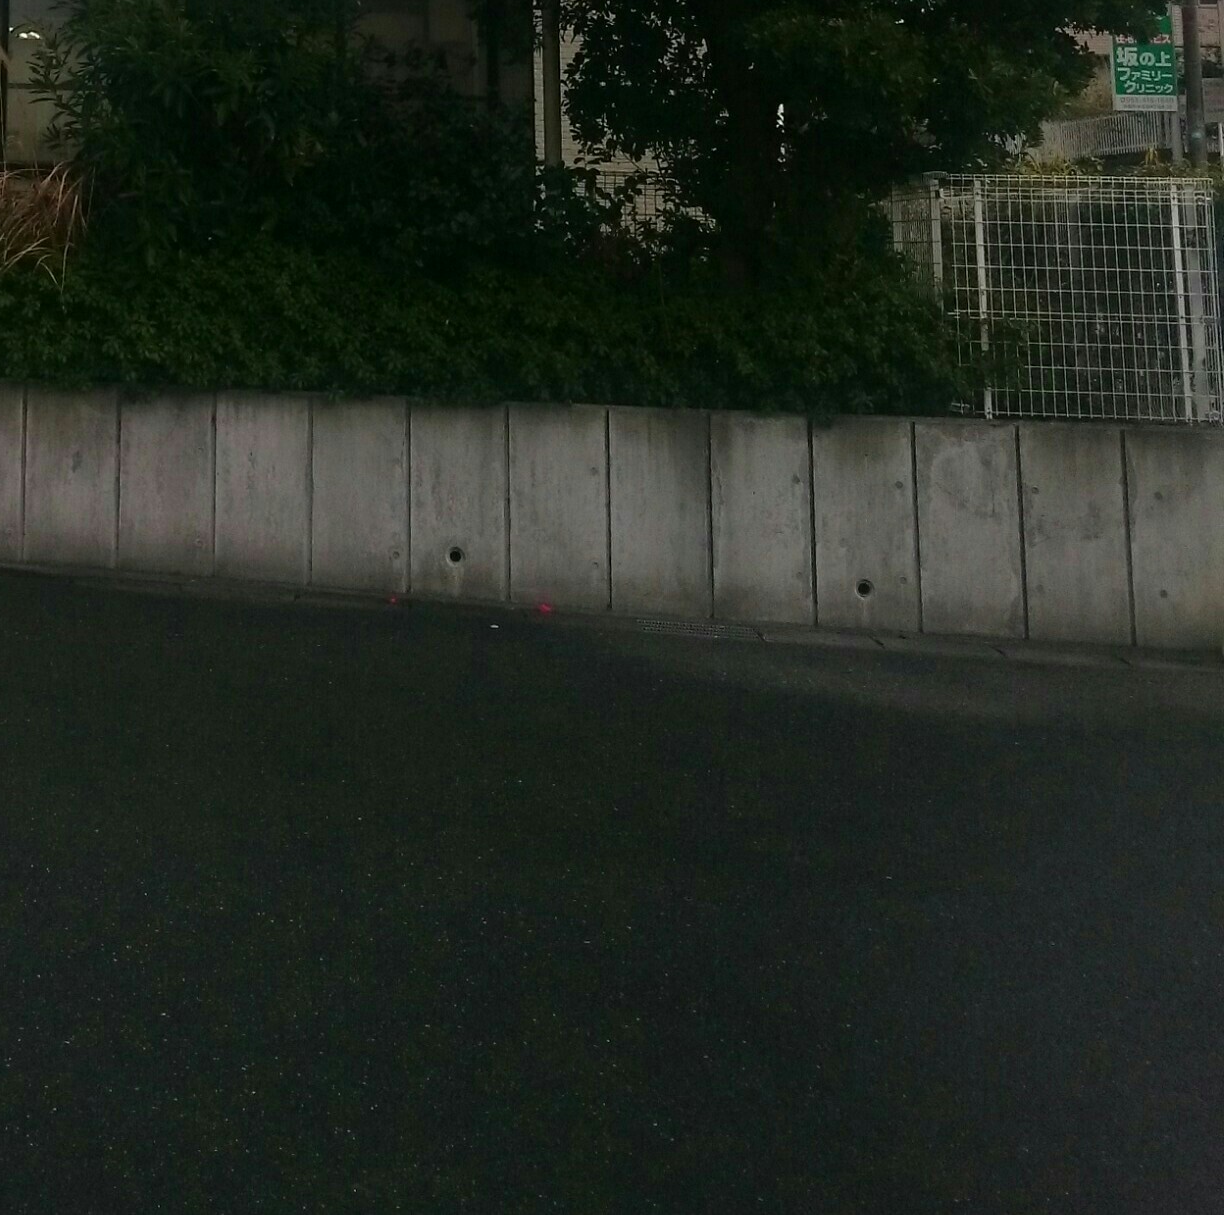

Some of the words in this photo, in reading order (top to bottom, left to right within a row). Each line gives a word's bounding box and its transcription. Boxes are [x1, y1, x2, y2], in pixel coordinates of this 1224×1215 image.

[1116, 46, 1172, 67] 坂の上
[1117, 67, 1173, 81] ファミリー
[1124, 81, 1174, 94] クリニック
